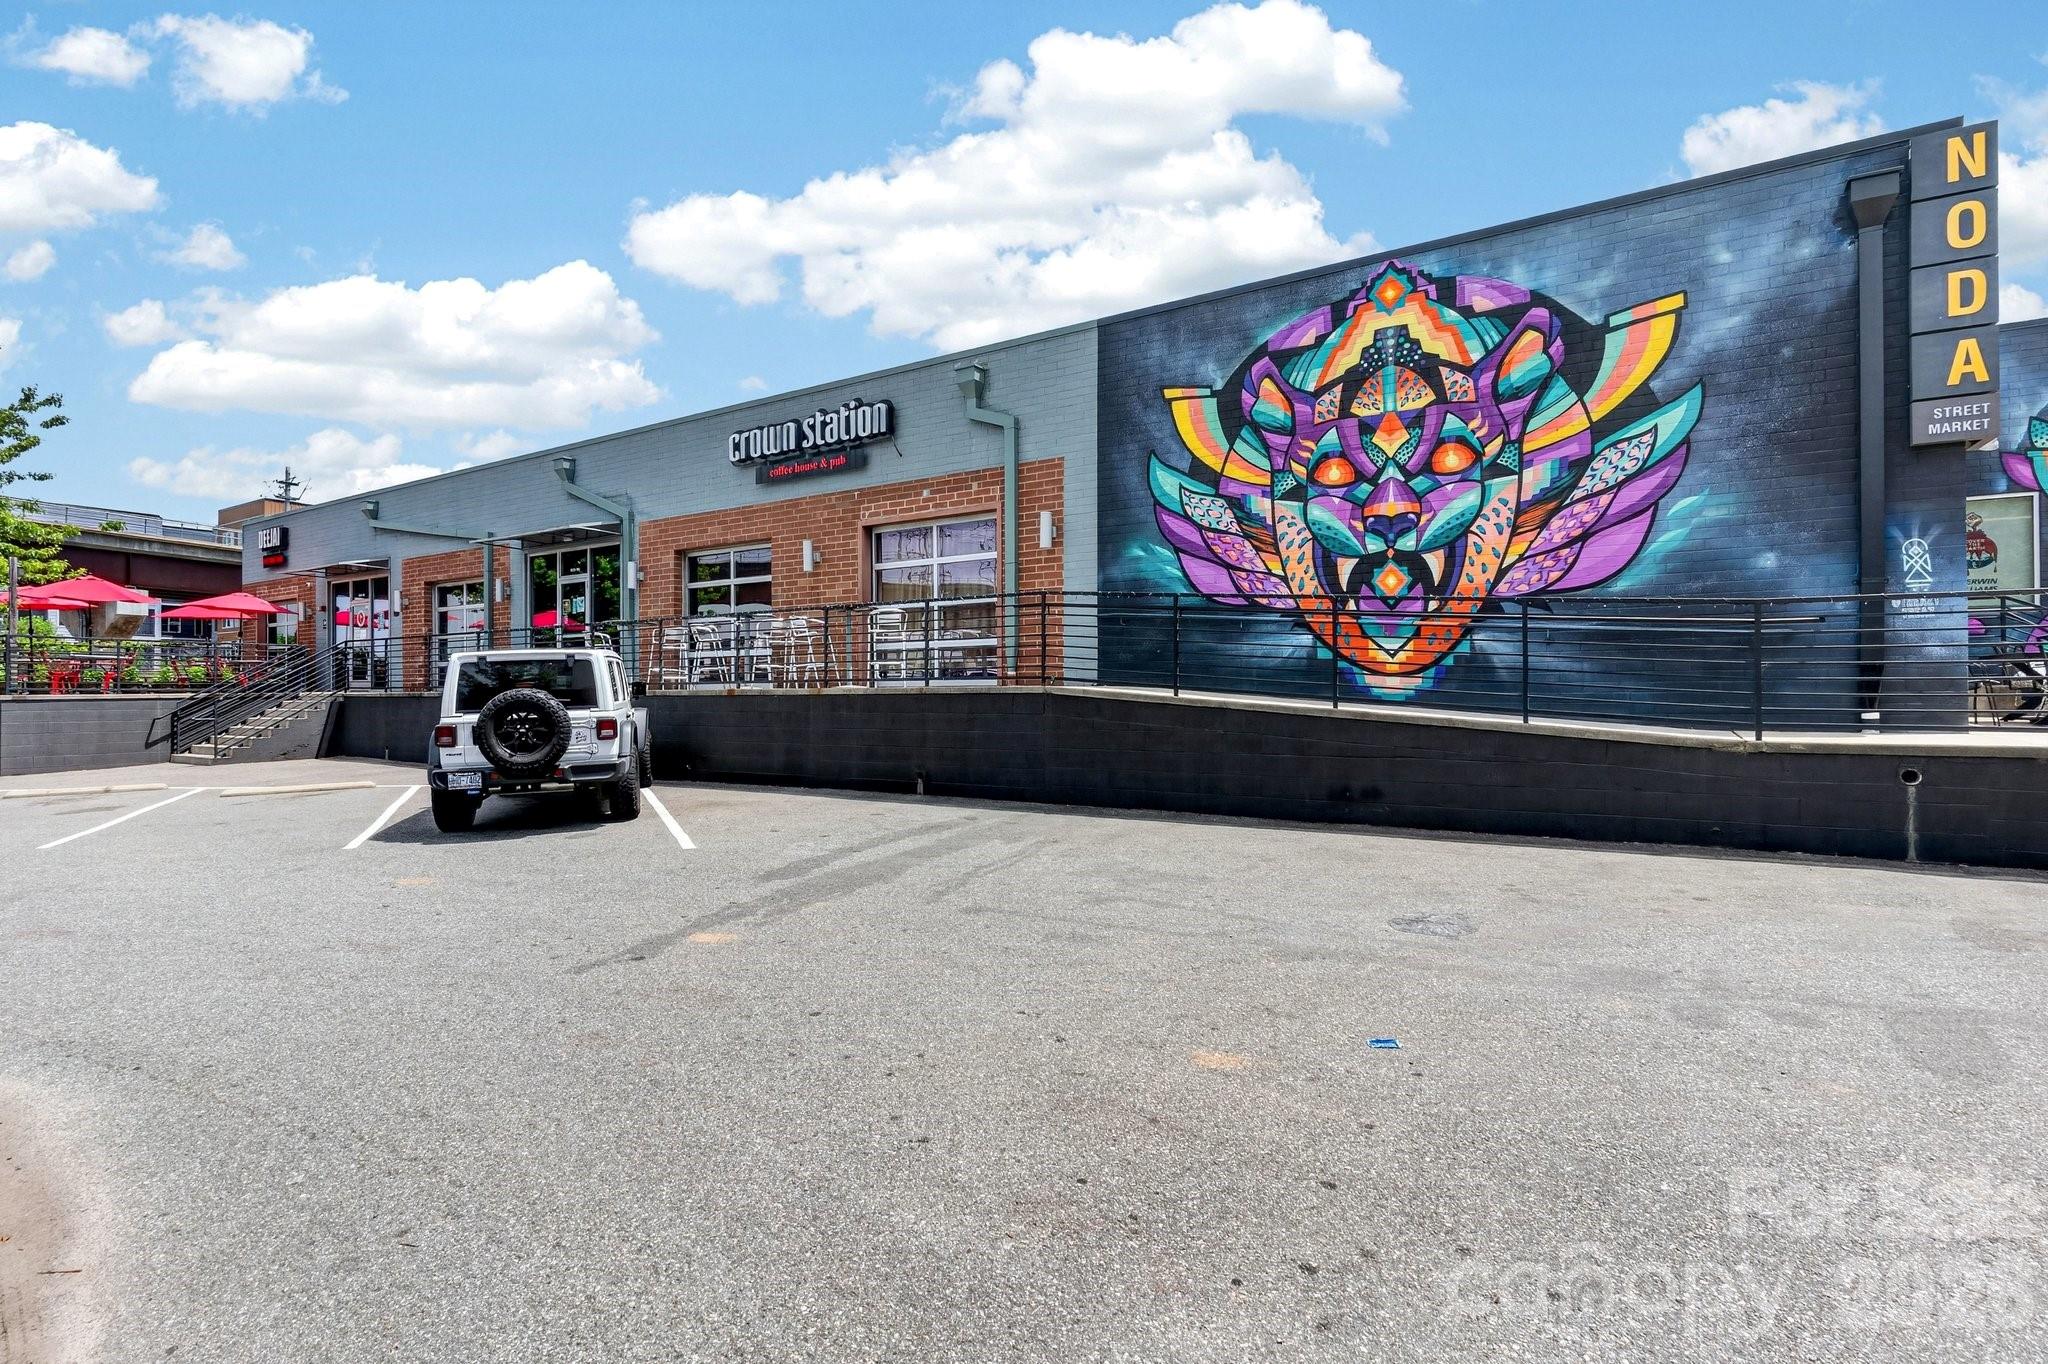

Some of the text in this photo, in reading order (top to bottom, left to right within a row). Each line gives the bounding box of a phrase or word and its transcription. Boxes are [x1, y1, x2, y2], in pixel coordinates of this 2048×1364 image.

[1946, 131, 1990, 386] NODA
[1933, 402, 1991, 419] STREET
[801, 399, 888, 448] station
[1928, 418, 1991, 435] MARKET
[768, 454, 847, 479] coffee house & pub
